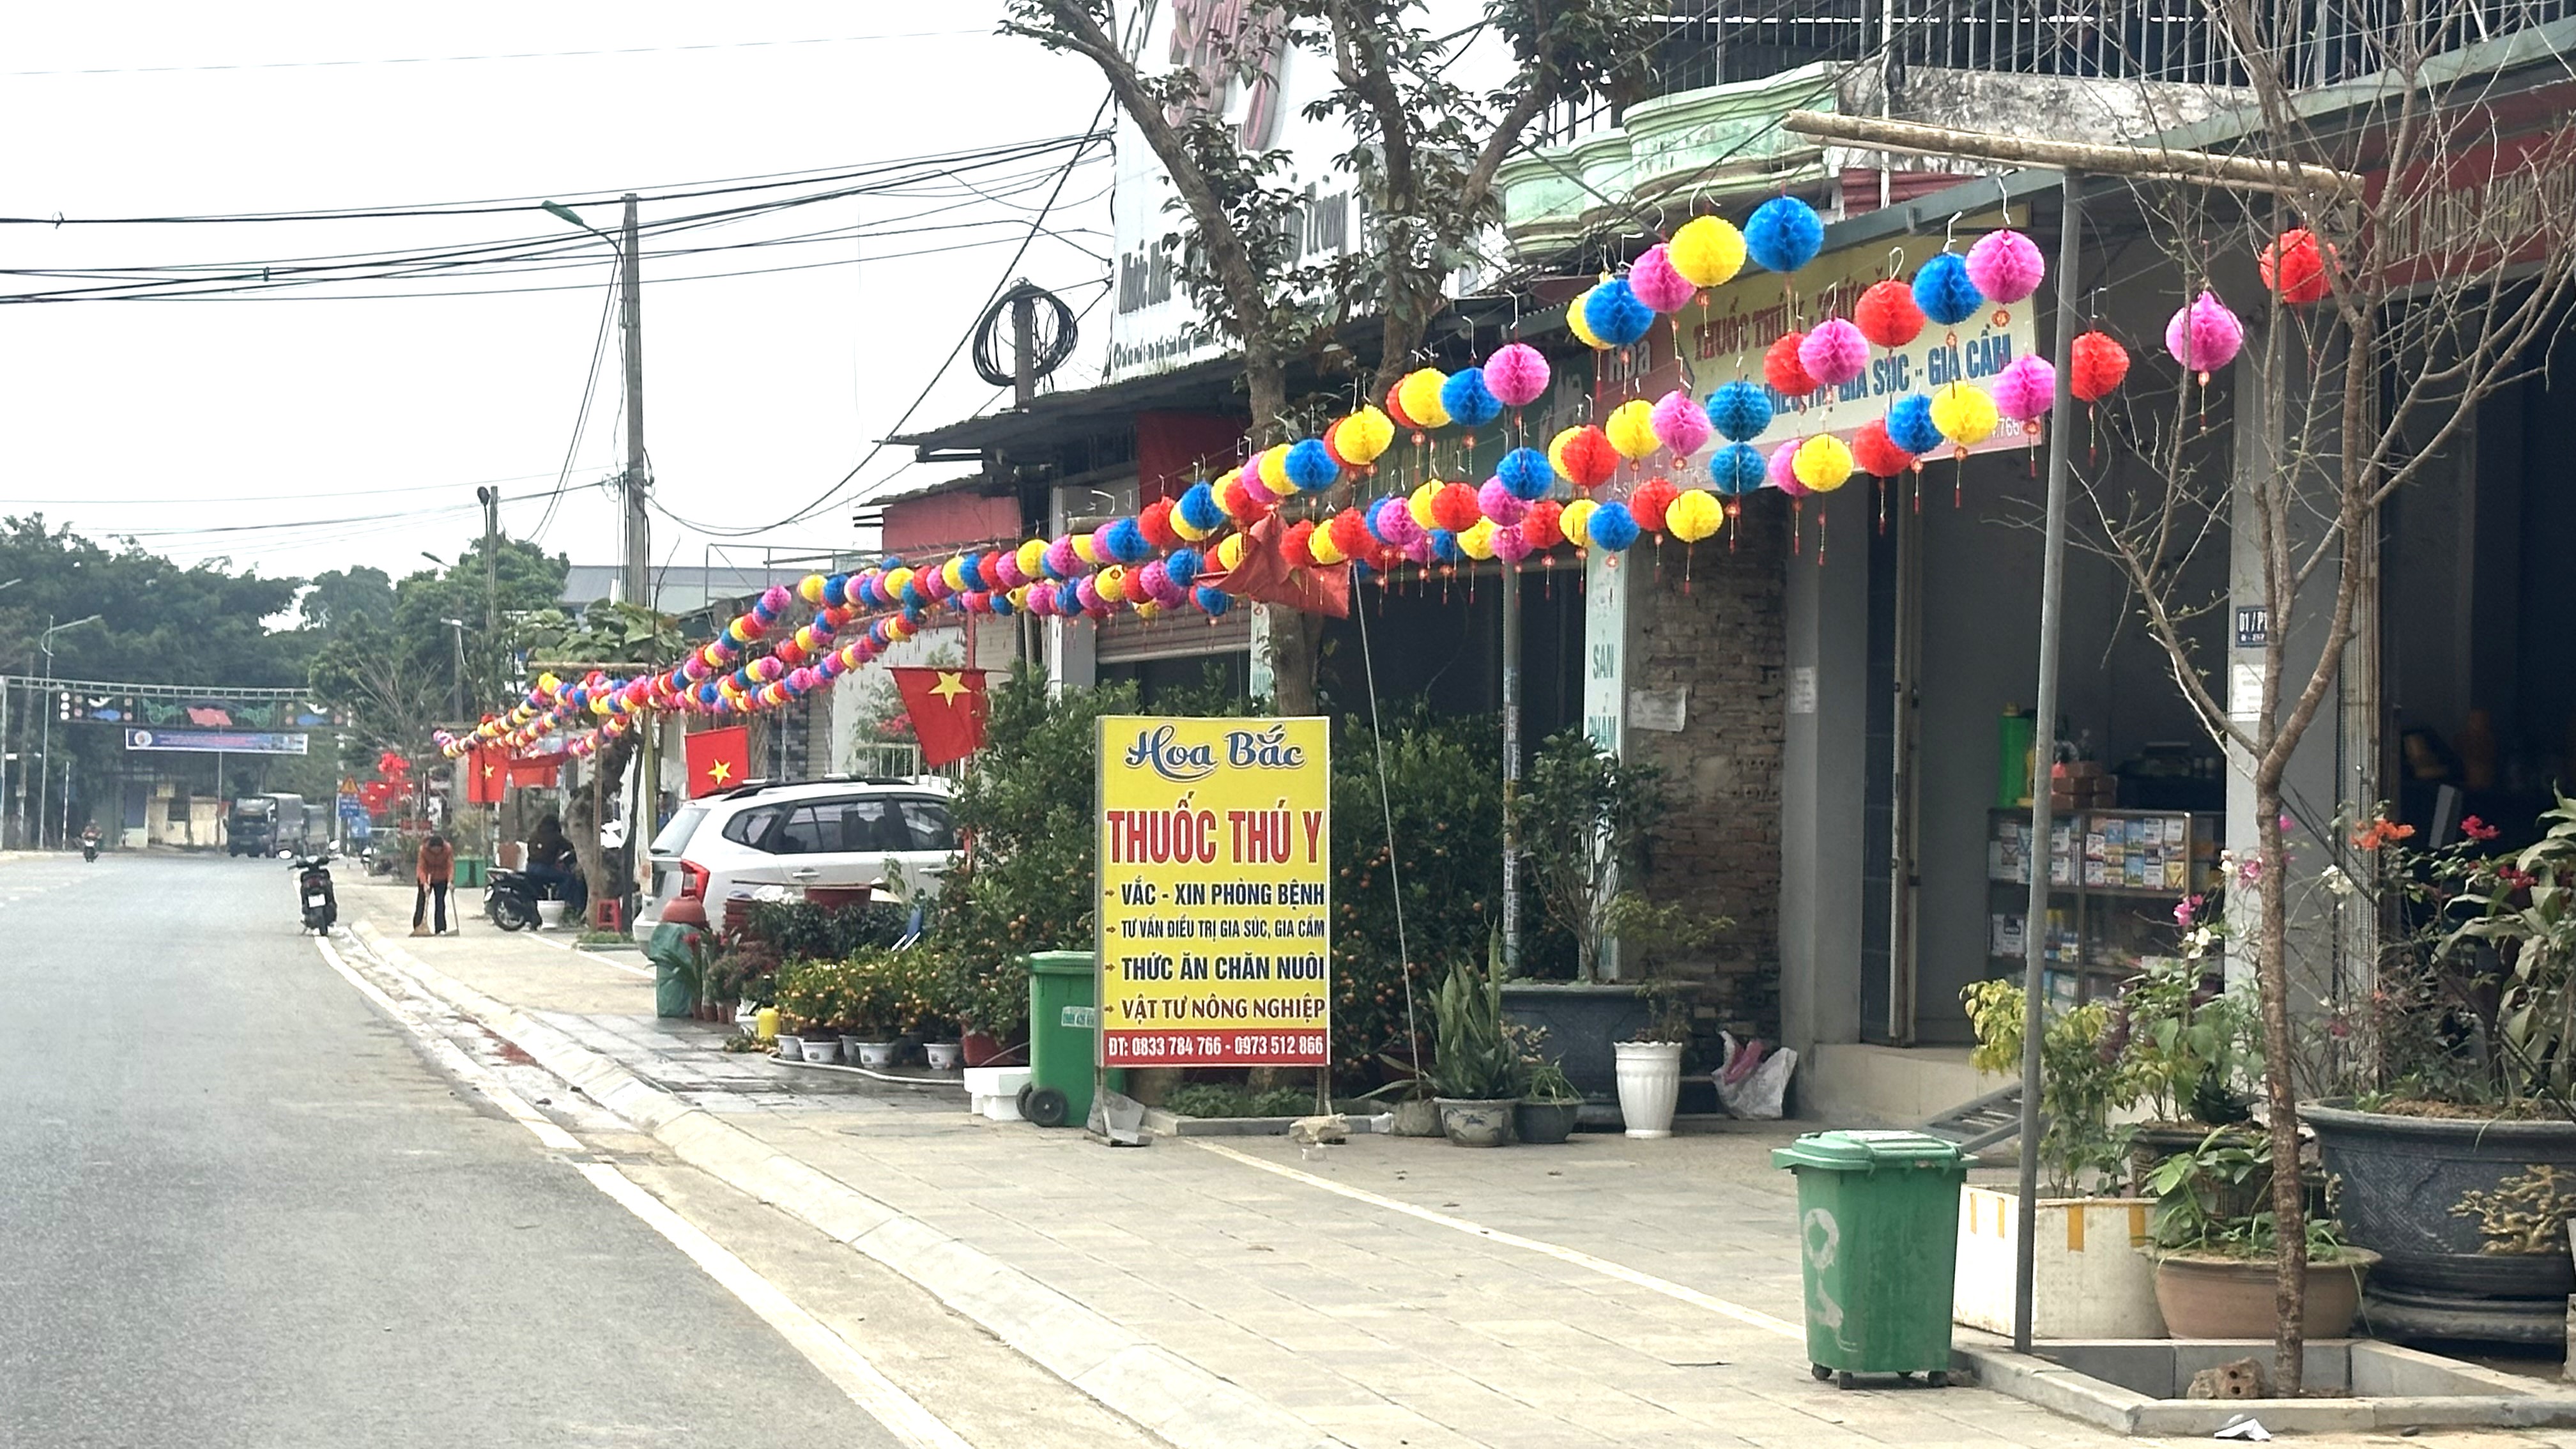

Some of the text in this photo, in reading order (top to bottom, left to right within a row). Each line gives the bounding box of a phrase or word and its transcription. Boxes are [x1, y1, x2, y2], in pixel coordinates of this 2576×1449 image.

[1694, 296, 1749, 362] THUỐC
[1928, 345, 1961, 386] GIA
[1966, 323, 2012, 379] CẦM
[1125, 724, 1305, 779] Hoa Bắc
[1107, 791, 1322, 864] THUỐC THÚ Y
[1121, 875, 1156, 905] VẮC
[1174, 883, 1206, 905] XIN
[1211, 877, 1272, 905] PHÒNG
[1277, 878, 1324, 911] BỆNH
[1121, 918, 1137, 939] TƯ
[1139, 913, 1163, 939] VẤN
[1198, 920, 1216, 942] TRỊ
[1220, 919, 1240, 938] GIA
[1275, 919, 1294, 938] GIA
[1298, 913, 1325, 938] CẦM
[1121, 951, 1324, 981] THỨC ĂN CHĂN NUÔI
[1121, 993, 1158, 1025] VẬT
[1162, 995, 1188, 1019] TƯ
[1192, 992, 1248, 1019] NÔNG
[1253, 992, 1326, 1023] NGHIỆP
[1132, 1036, 1165, 1056] 0833
[1168, 1036, 1193, 1055] 784
[1197, 1036, 1222, 1055] 766
[1234, 1036, 1267, 1055] 0973
[1270, 1036, 1296, 1055] 512
[1299, 1036, 1323, 1055] 866
